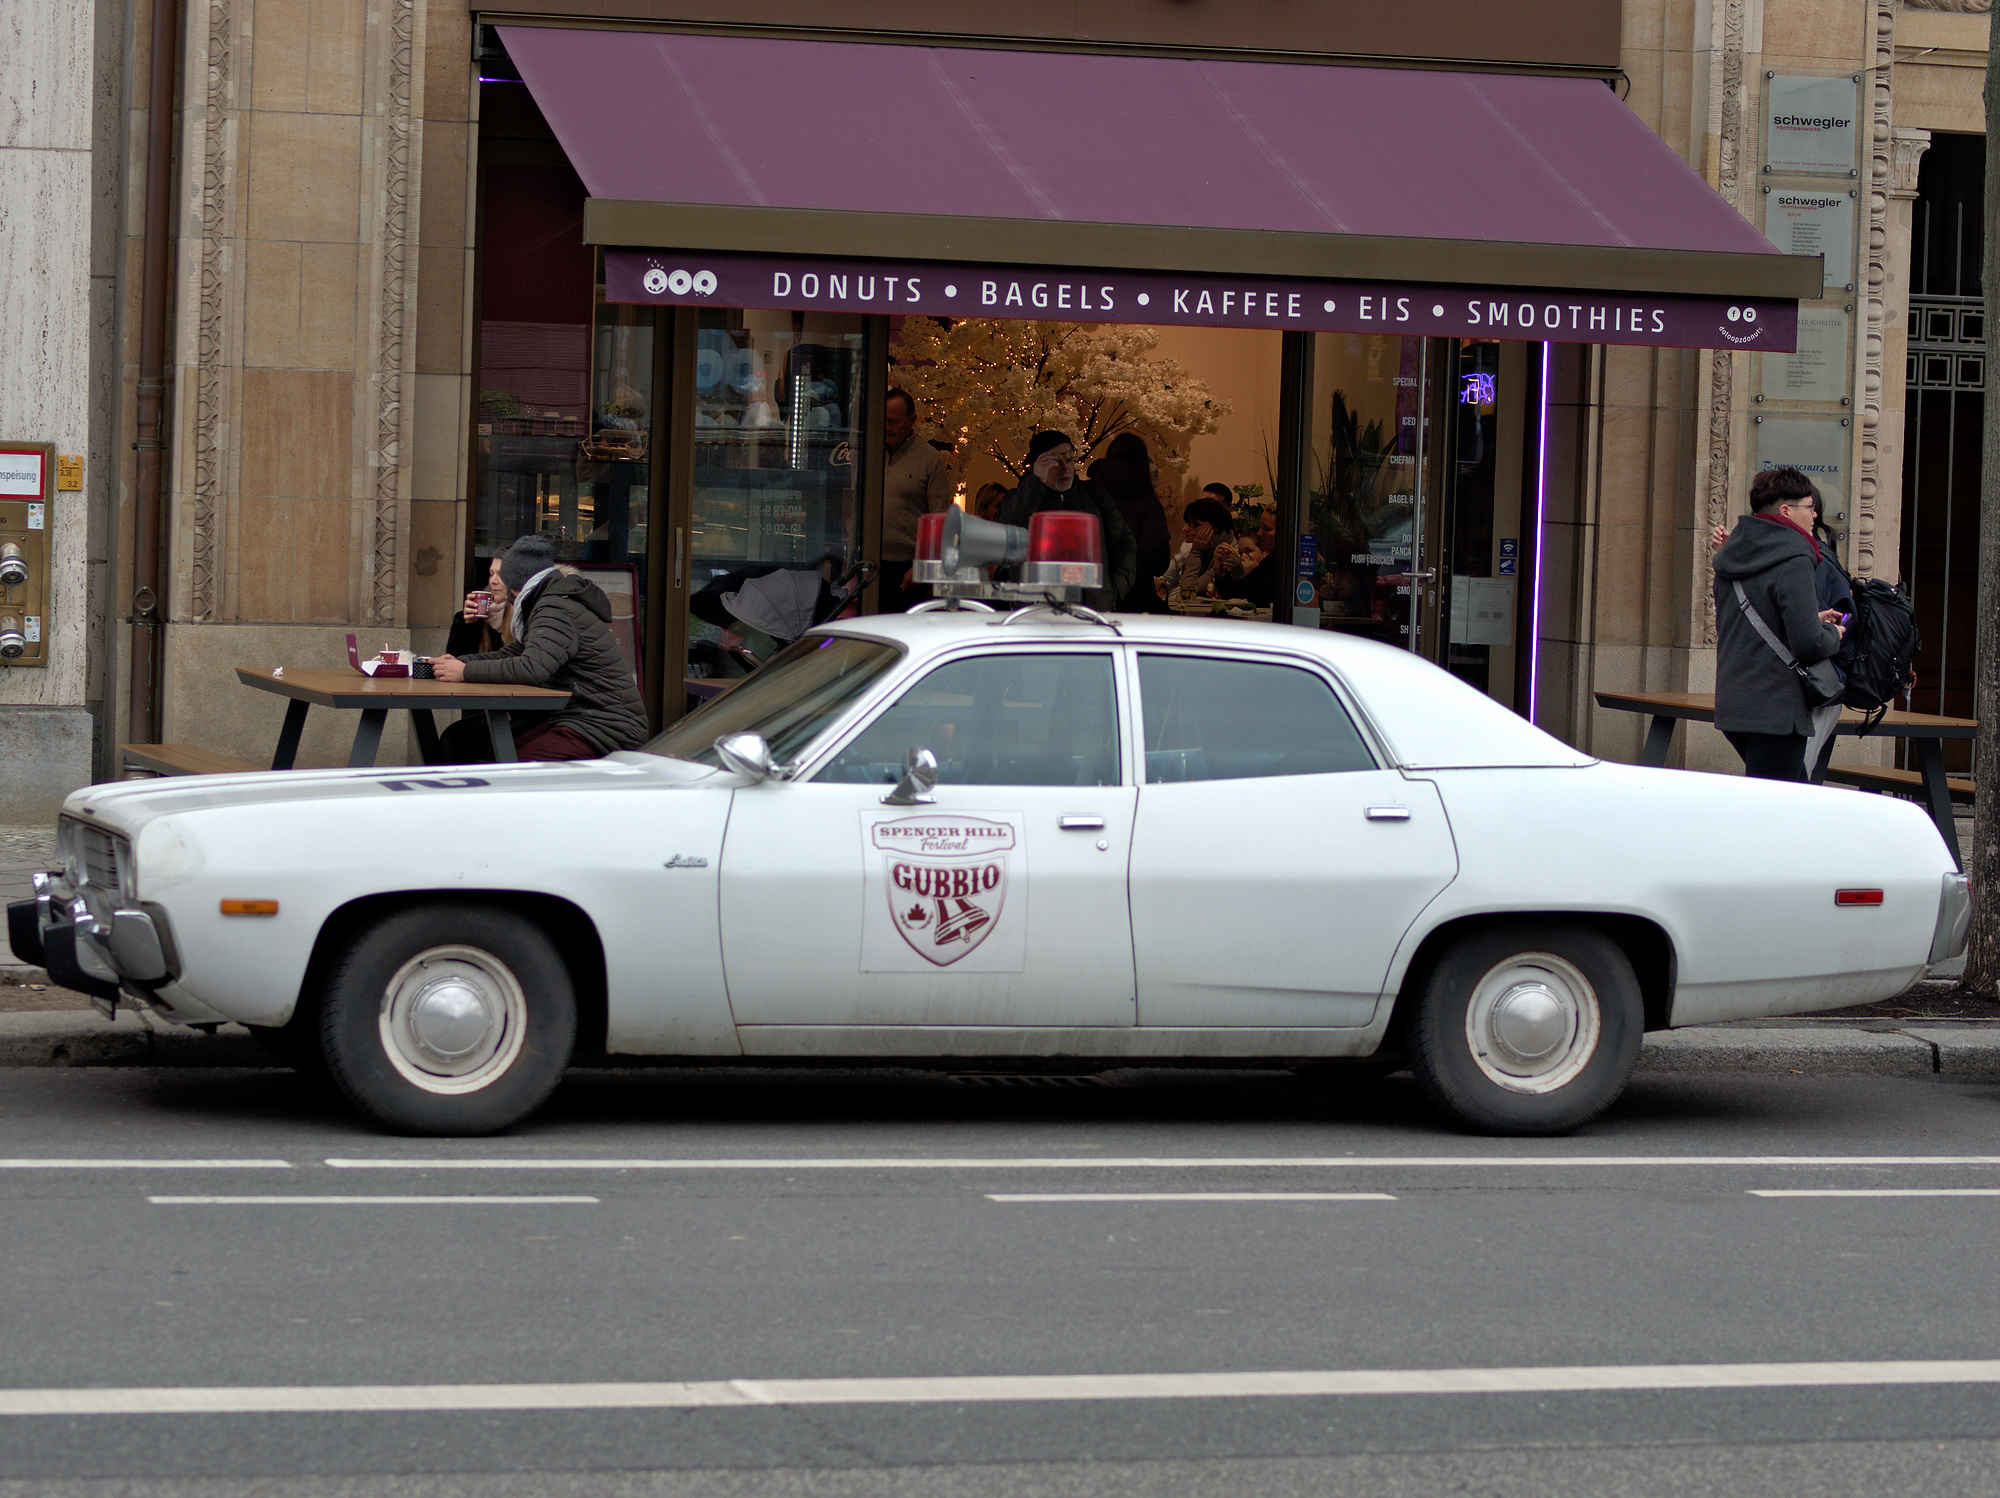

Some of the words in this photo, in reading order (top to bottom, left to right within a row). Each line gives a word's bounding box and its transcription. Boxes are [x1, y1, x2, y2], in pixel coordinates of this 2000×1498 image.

[1773, 115, 1851, 130] schwegler
[1778, 196, 1842, 209] schwegler
[773, 272, 922, 303] DONUTS
[981, 280, 1115, 311] BAGELS
[1173, 289, 1302, 319] KAFFEE
[1359, 296, 1411, 322] EIS
[1467, 300, 1666, 334] SMOOTHIES
[1402, 417, 1416, 426] ICED
[67, 480, 78, 488] 3.2
[1388, 494, 1408, 504] BAGEL
[880, 827, 960, 837] SPENCER
[964, 827, 1007, 837] HILL
[920, 837, 969, 852] Festival
[892, 863, 1000, 899] GUBBIO
